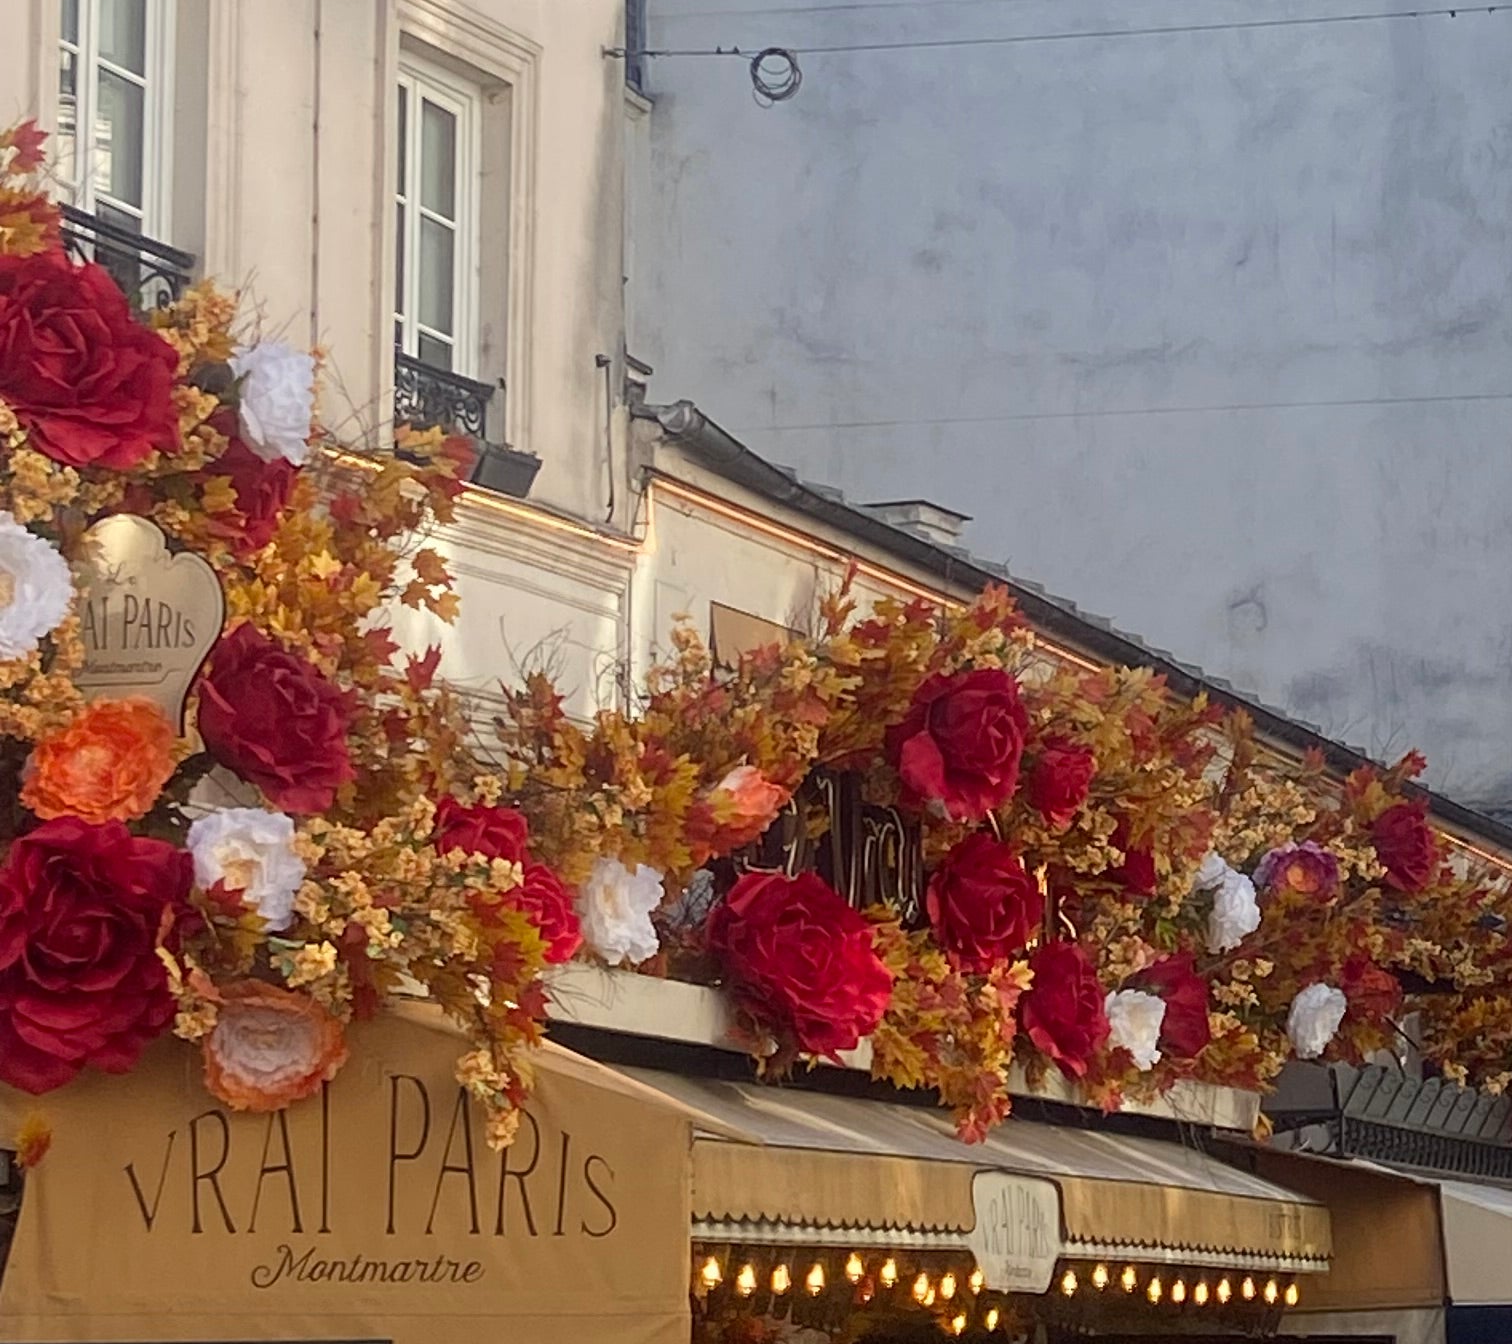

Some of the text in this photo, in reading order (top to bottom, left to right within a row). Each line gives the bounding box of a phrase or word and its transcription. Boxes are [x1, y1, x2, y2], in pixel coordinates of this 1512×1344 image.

[83, 594, 196, 650] AI PARIS
[123, 1074, 618, 1238] VRAI PARIS
[250, 1243, 487, 1289] Montmartre
